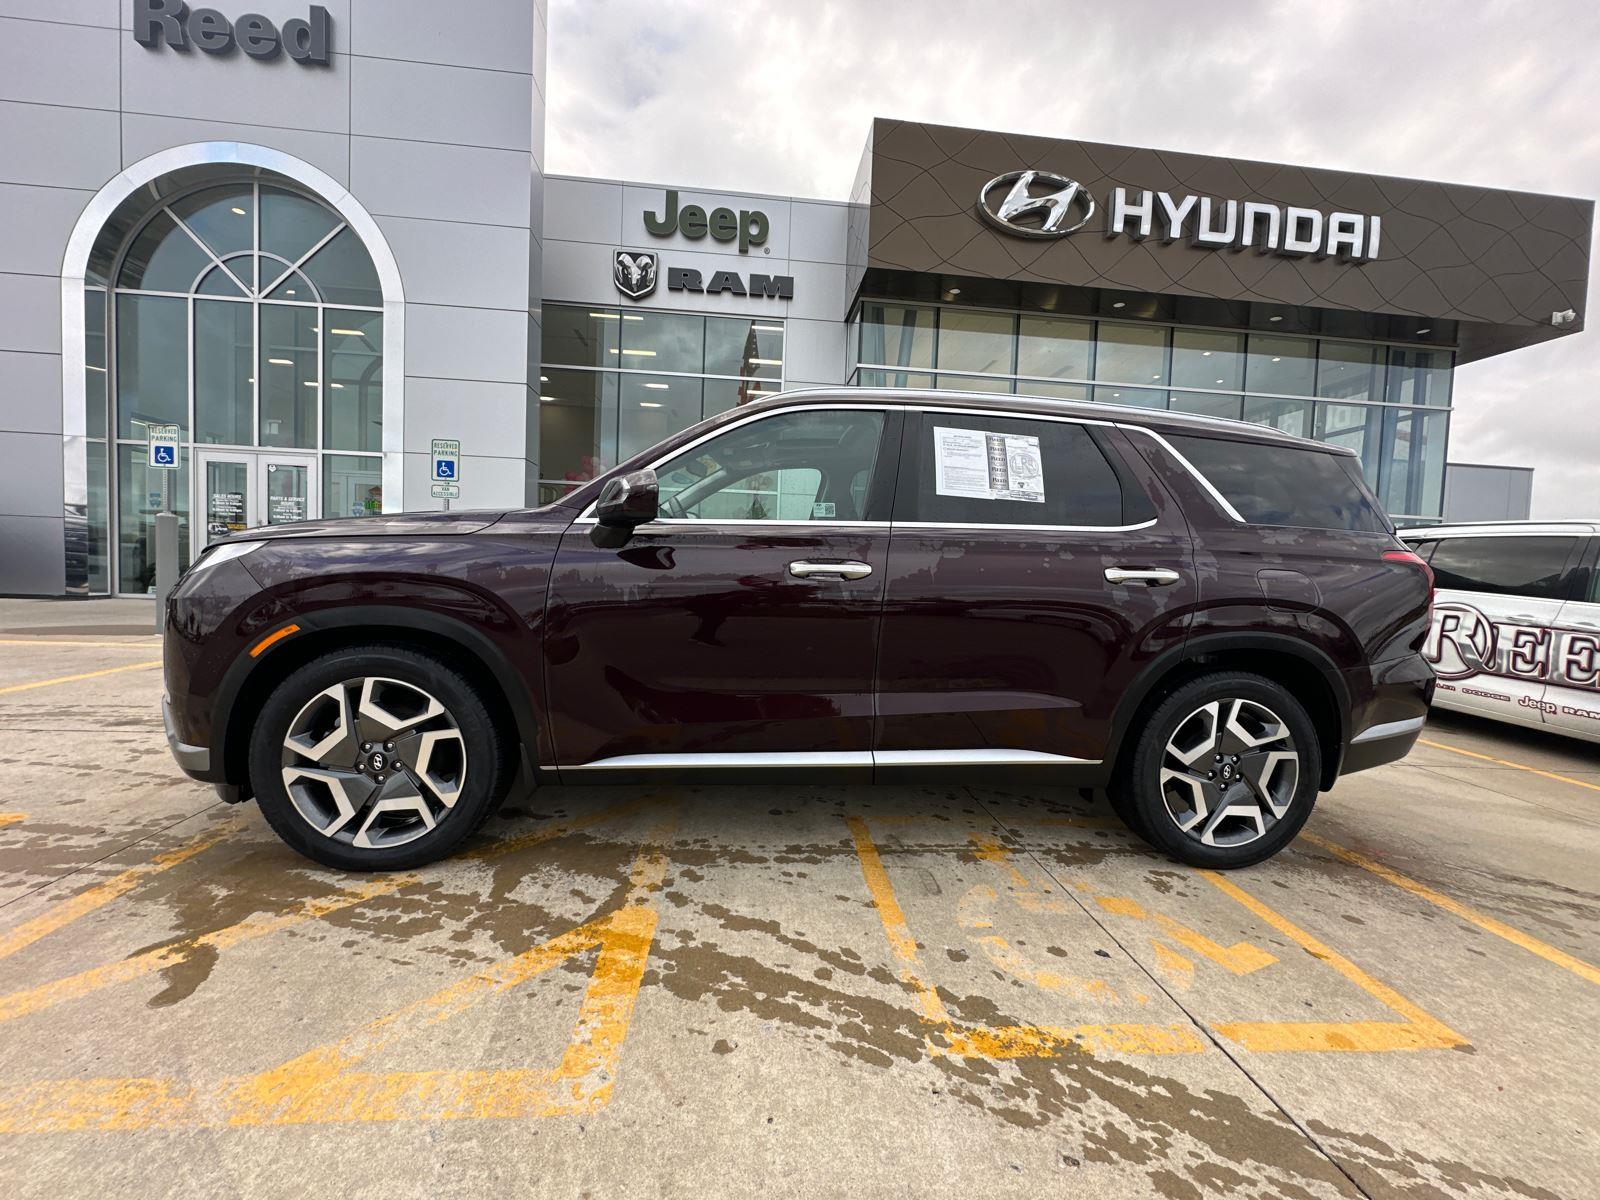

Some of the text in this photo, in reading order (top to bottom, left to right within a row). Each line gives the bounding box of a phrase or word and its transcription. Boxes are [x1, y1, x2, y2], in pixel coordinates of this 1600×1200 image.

[134, 0, 331, 66] Reed
[643, 190, 770, 254] Jeep
[1107, 187, 1381, 263] HYUNDAI
[668, 267, 794, 299] RAM
[151, 426, 177, 435] RESERVED
[151, 435, 177, 443] PARKING
[433, 442, 458, 450] RESERVED
[1462, 687, 1511, 701] DODGE
[1518, 696, 1557, 714] Jeep
